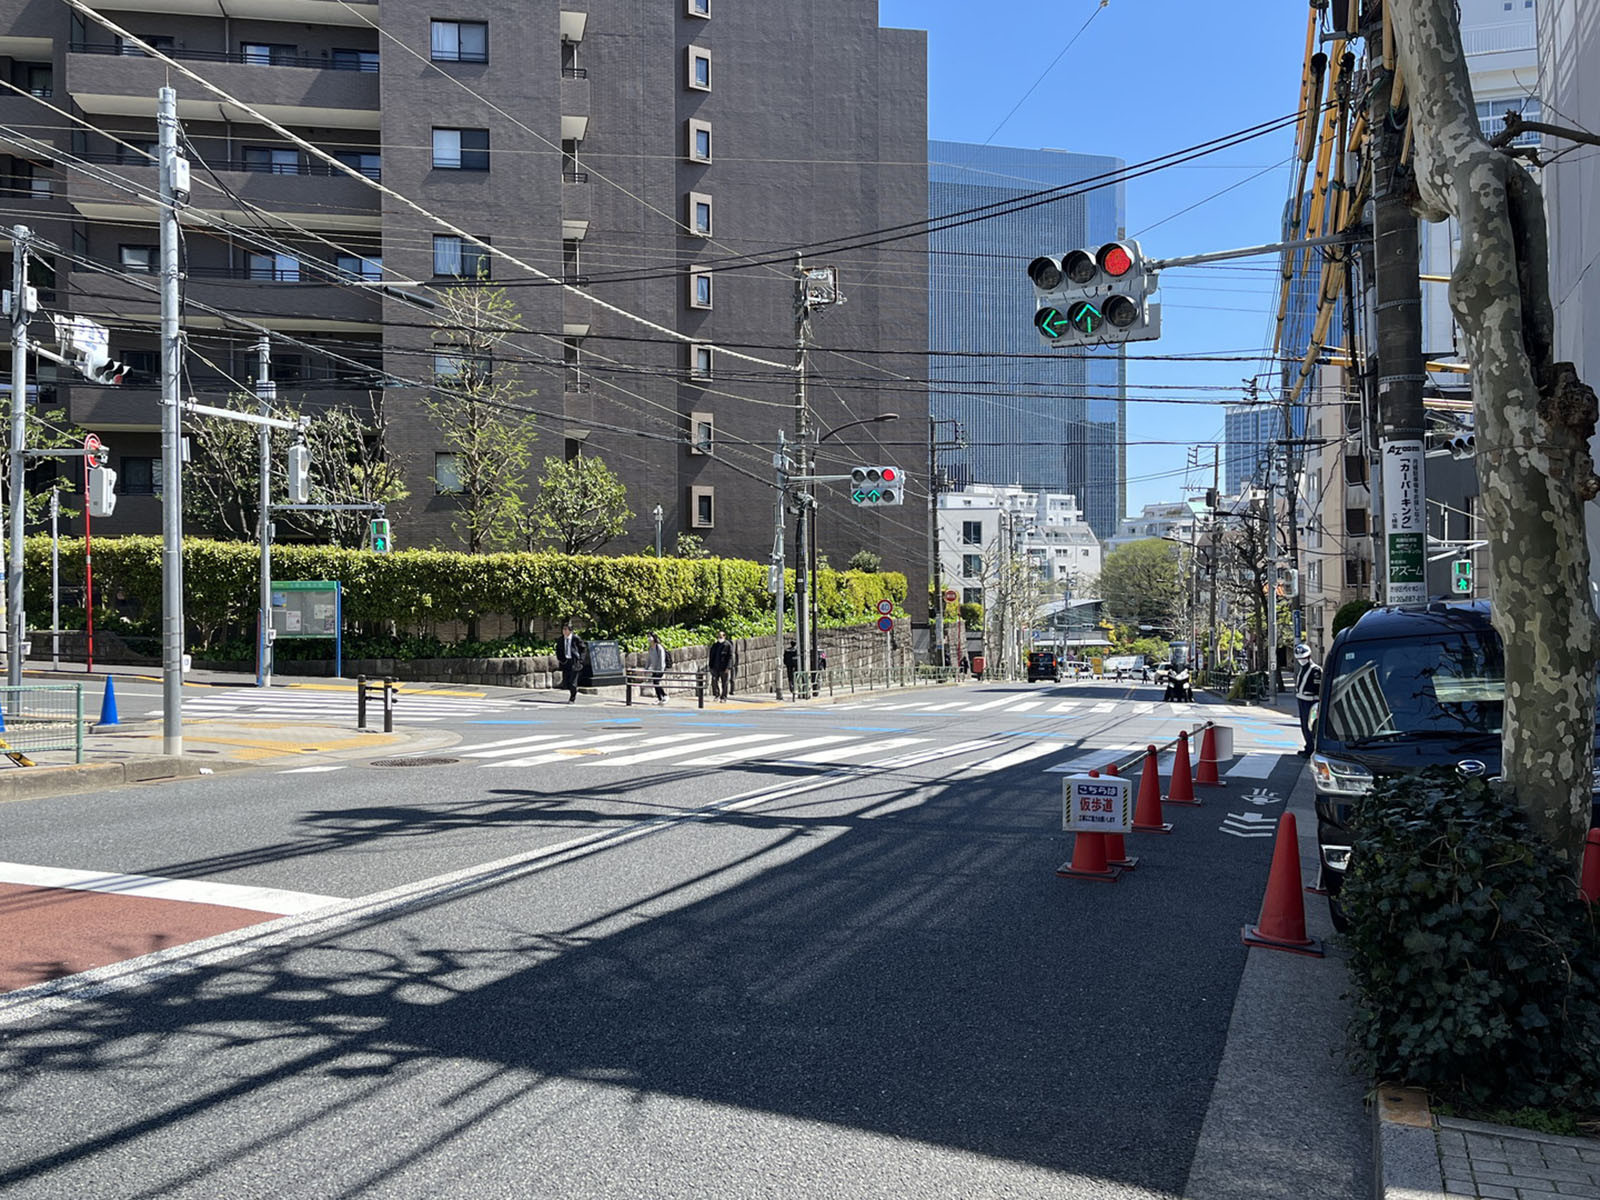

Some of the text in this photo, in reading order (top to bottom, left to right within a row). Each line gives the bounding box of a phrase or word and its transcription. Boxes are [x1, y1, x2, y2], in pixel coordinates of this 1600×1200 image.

[1390, 566, 1422, 576] アズーム
[1080, 786, 1116, 794] こちらは
[1080, 798, 1112, 812] 仮歩道
